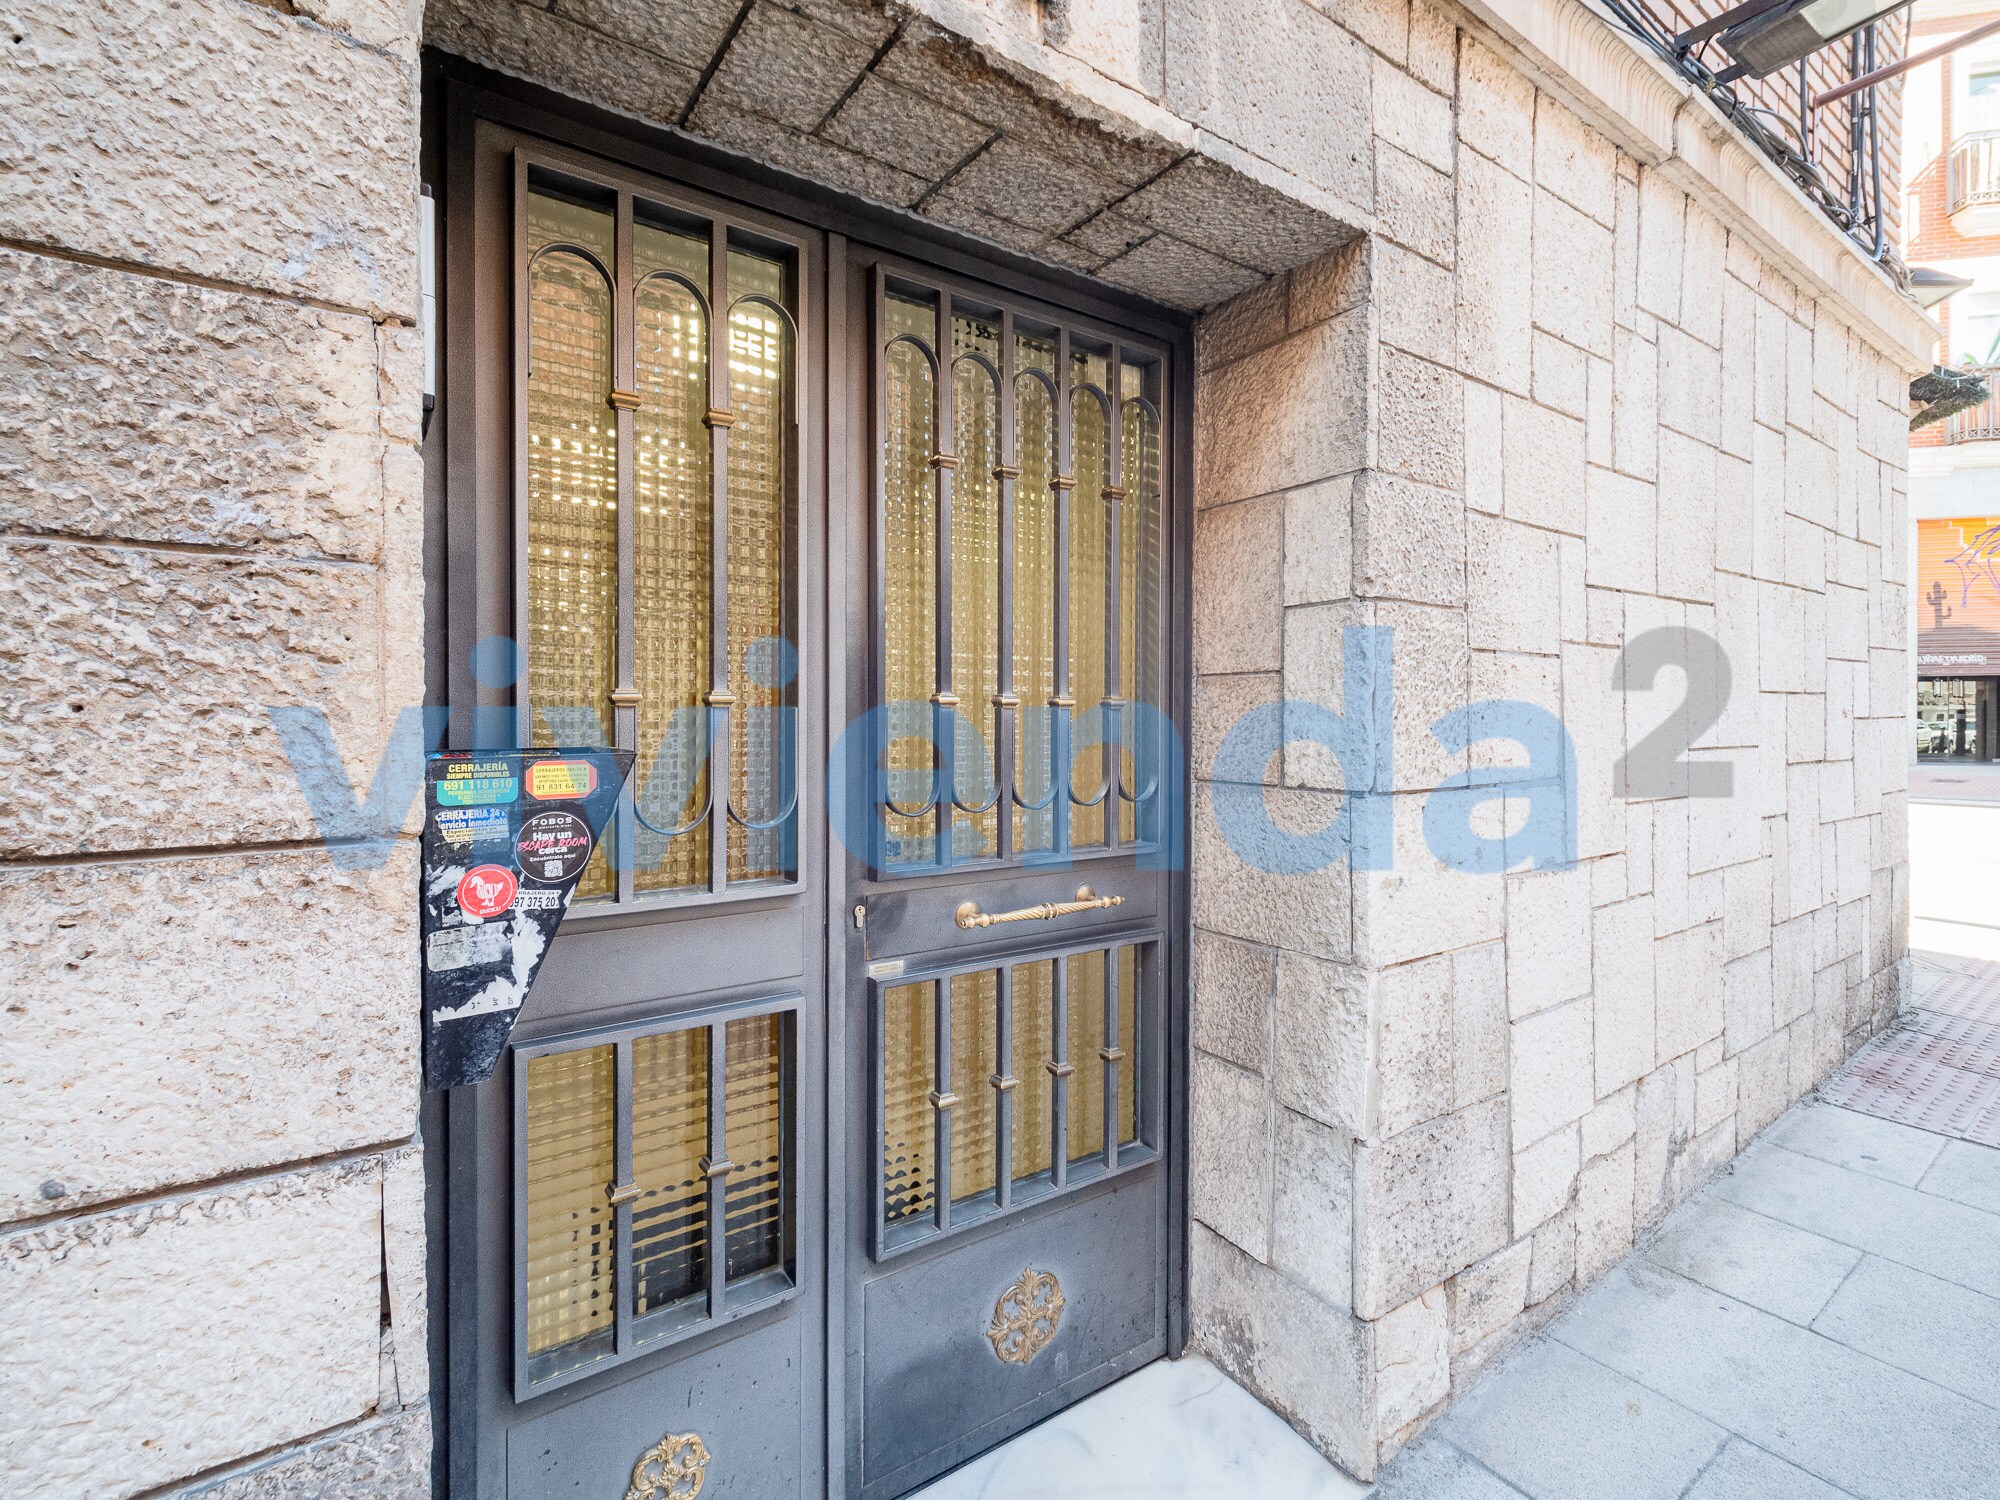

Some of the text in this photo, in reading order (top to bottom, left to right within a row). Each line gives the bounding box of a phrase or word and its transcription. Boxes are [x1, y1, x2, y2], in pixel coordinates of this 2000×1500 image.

[448, 761, 508, 772] CERRAJERÍA
[443, 779, 513, 791] 691 118 610
[438, 820, 467, 830] ervicio
[532, 816, 573, 826] FOBOS
[532, 831, 572, 842] Hay un
[517, 836, 588, 852] ESCAPE ROOM
